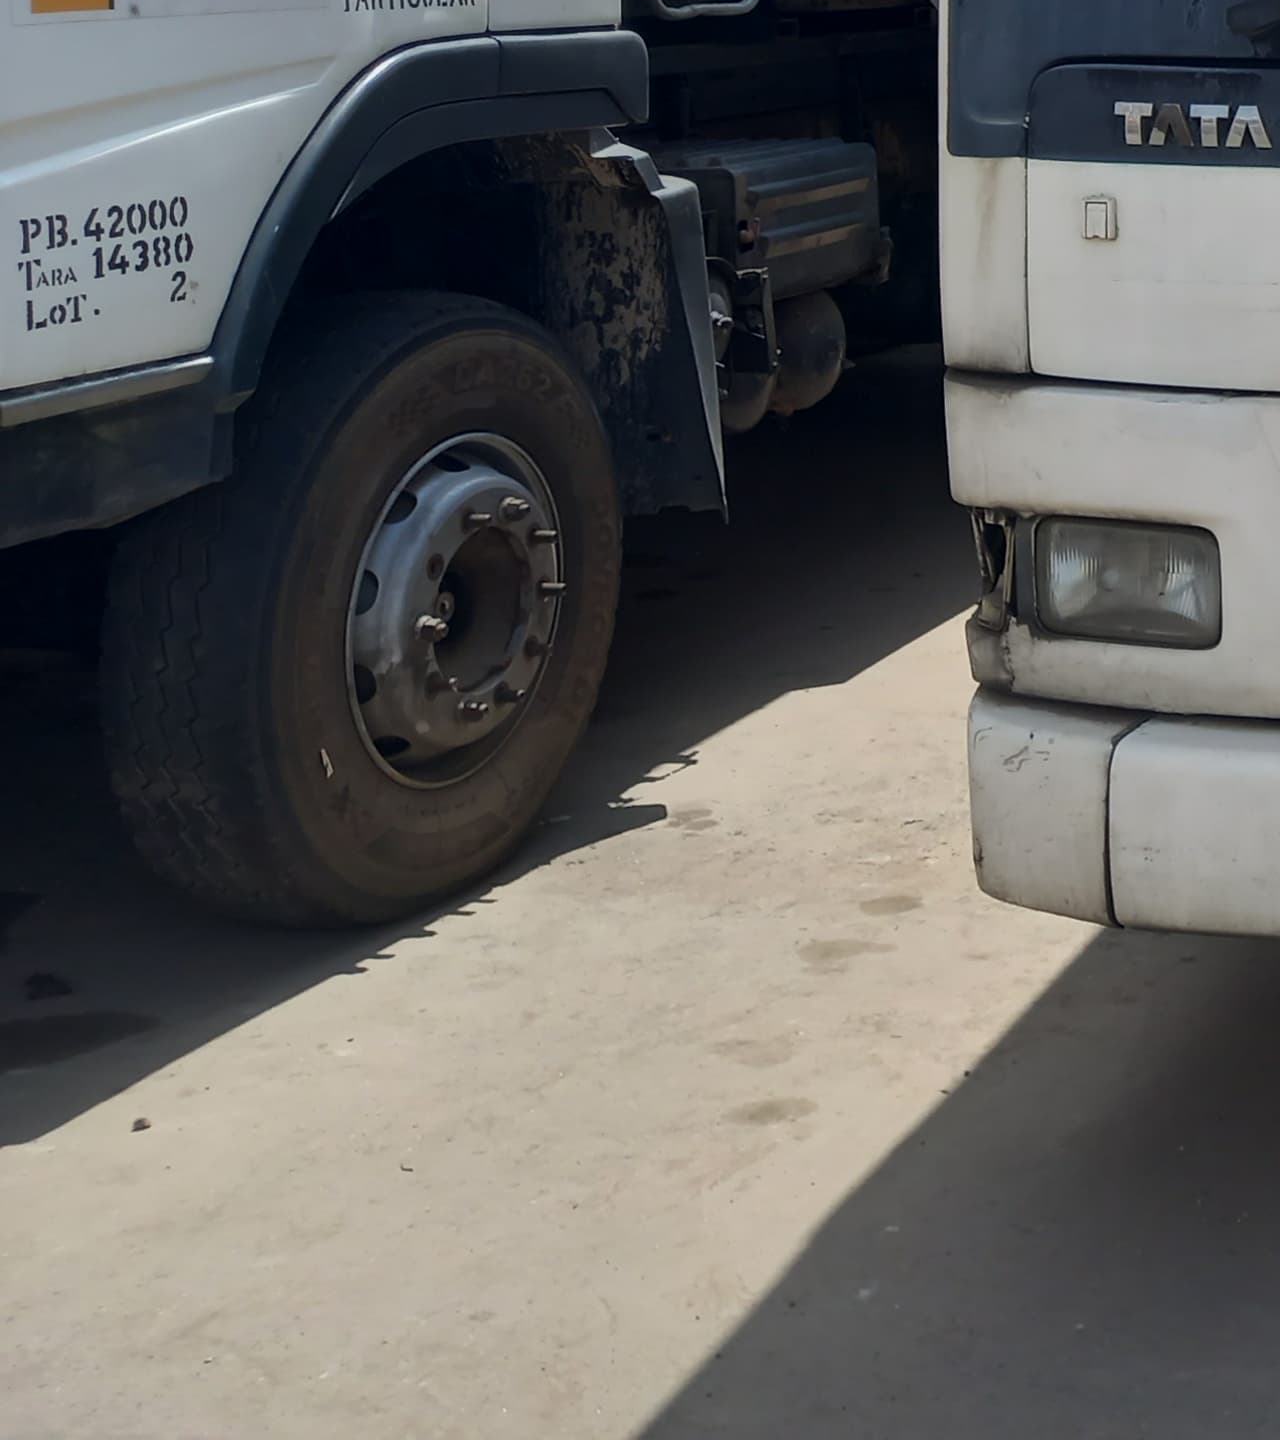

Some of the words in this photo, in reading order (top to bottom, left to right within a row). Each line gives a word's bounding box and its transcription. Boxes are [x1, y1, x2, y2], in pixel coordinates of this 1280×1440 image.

[1113, 102, 1273, 149] TATA
[92, 232, 194, 280] 14380
[170, 270, 188, 303] 2
